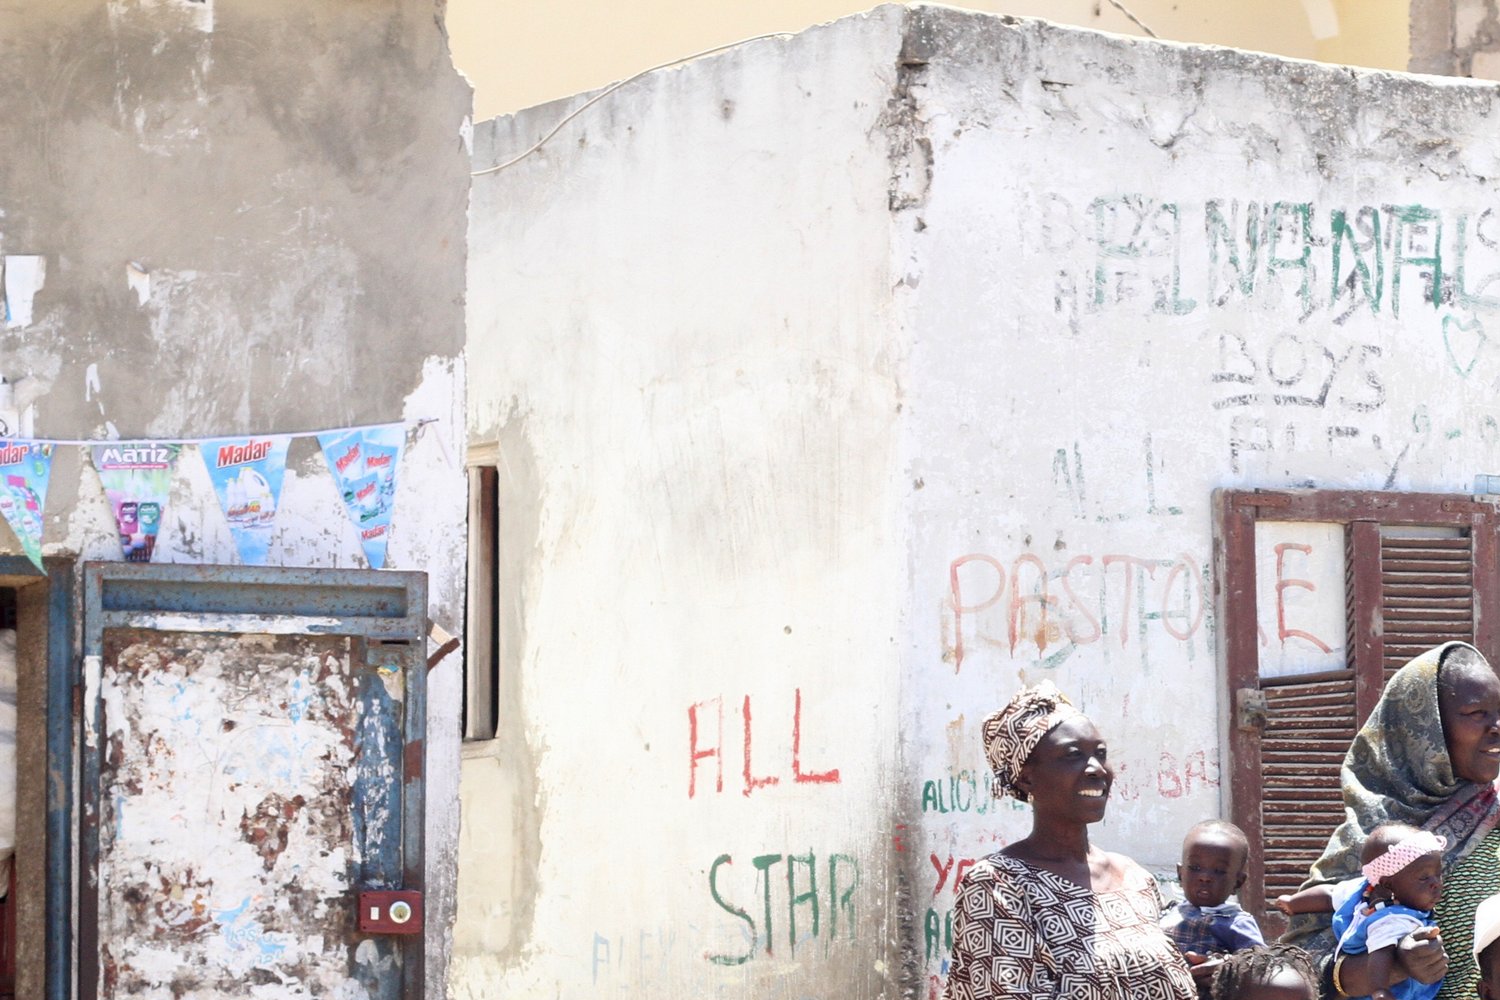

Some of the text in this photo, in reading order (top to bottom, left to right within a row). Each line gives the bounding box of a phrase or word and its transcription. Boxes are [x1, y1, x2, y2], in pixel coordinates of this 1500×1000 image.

[217, 439, 272, 469] Madar
[688, 687, 842, 800] ALL
[705, 846, 862, 966] STAR
